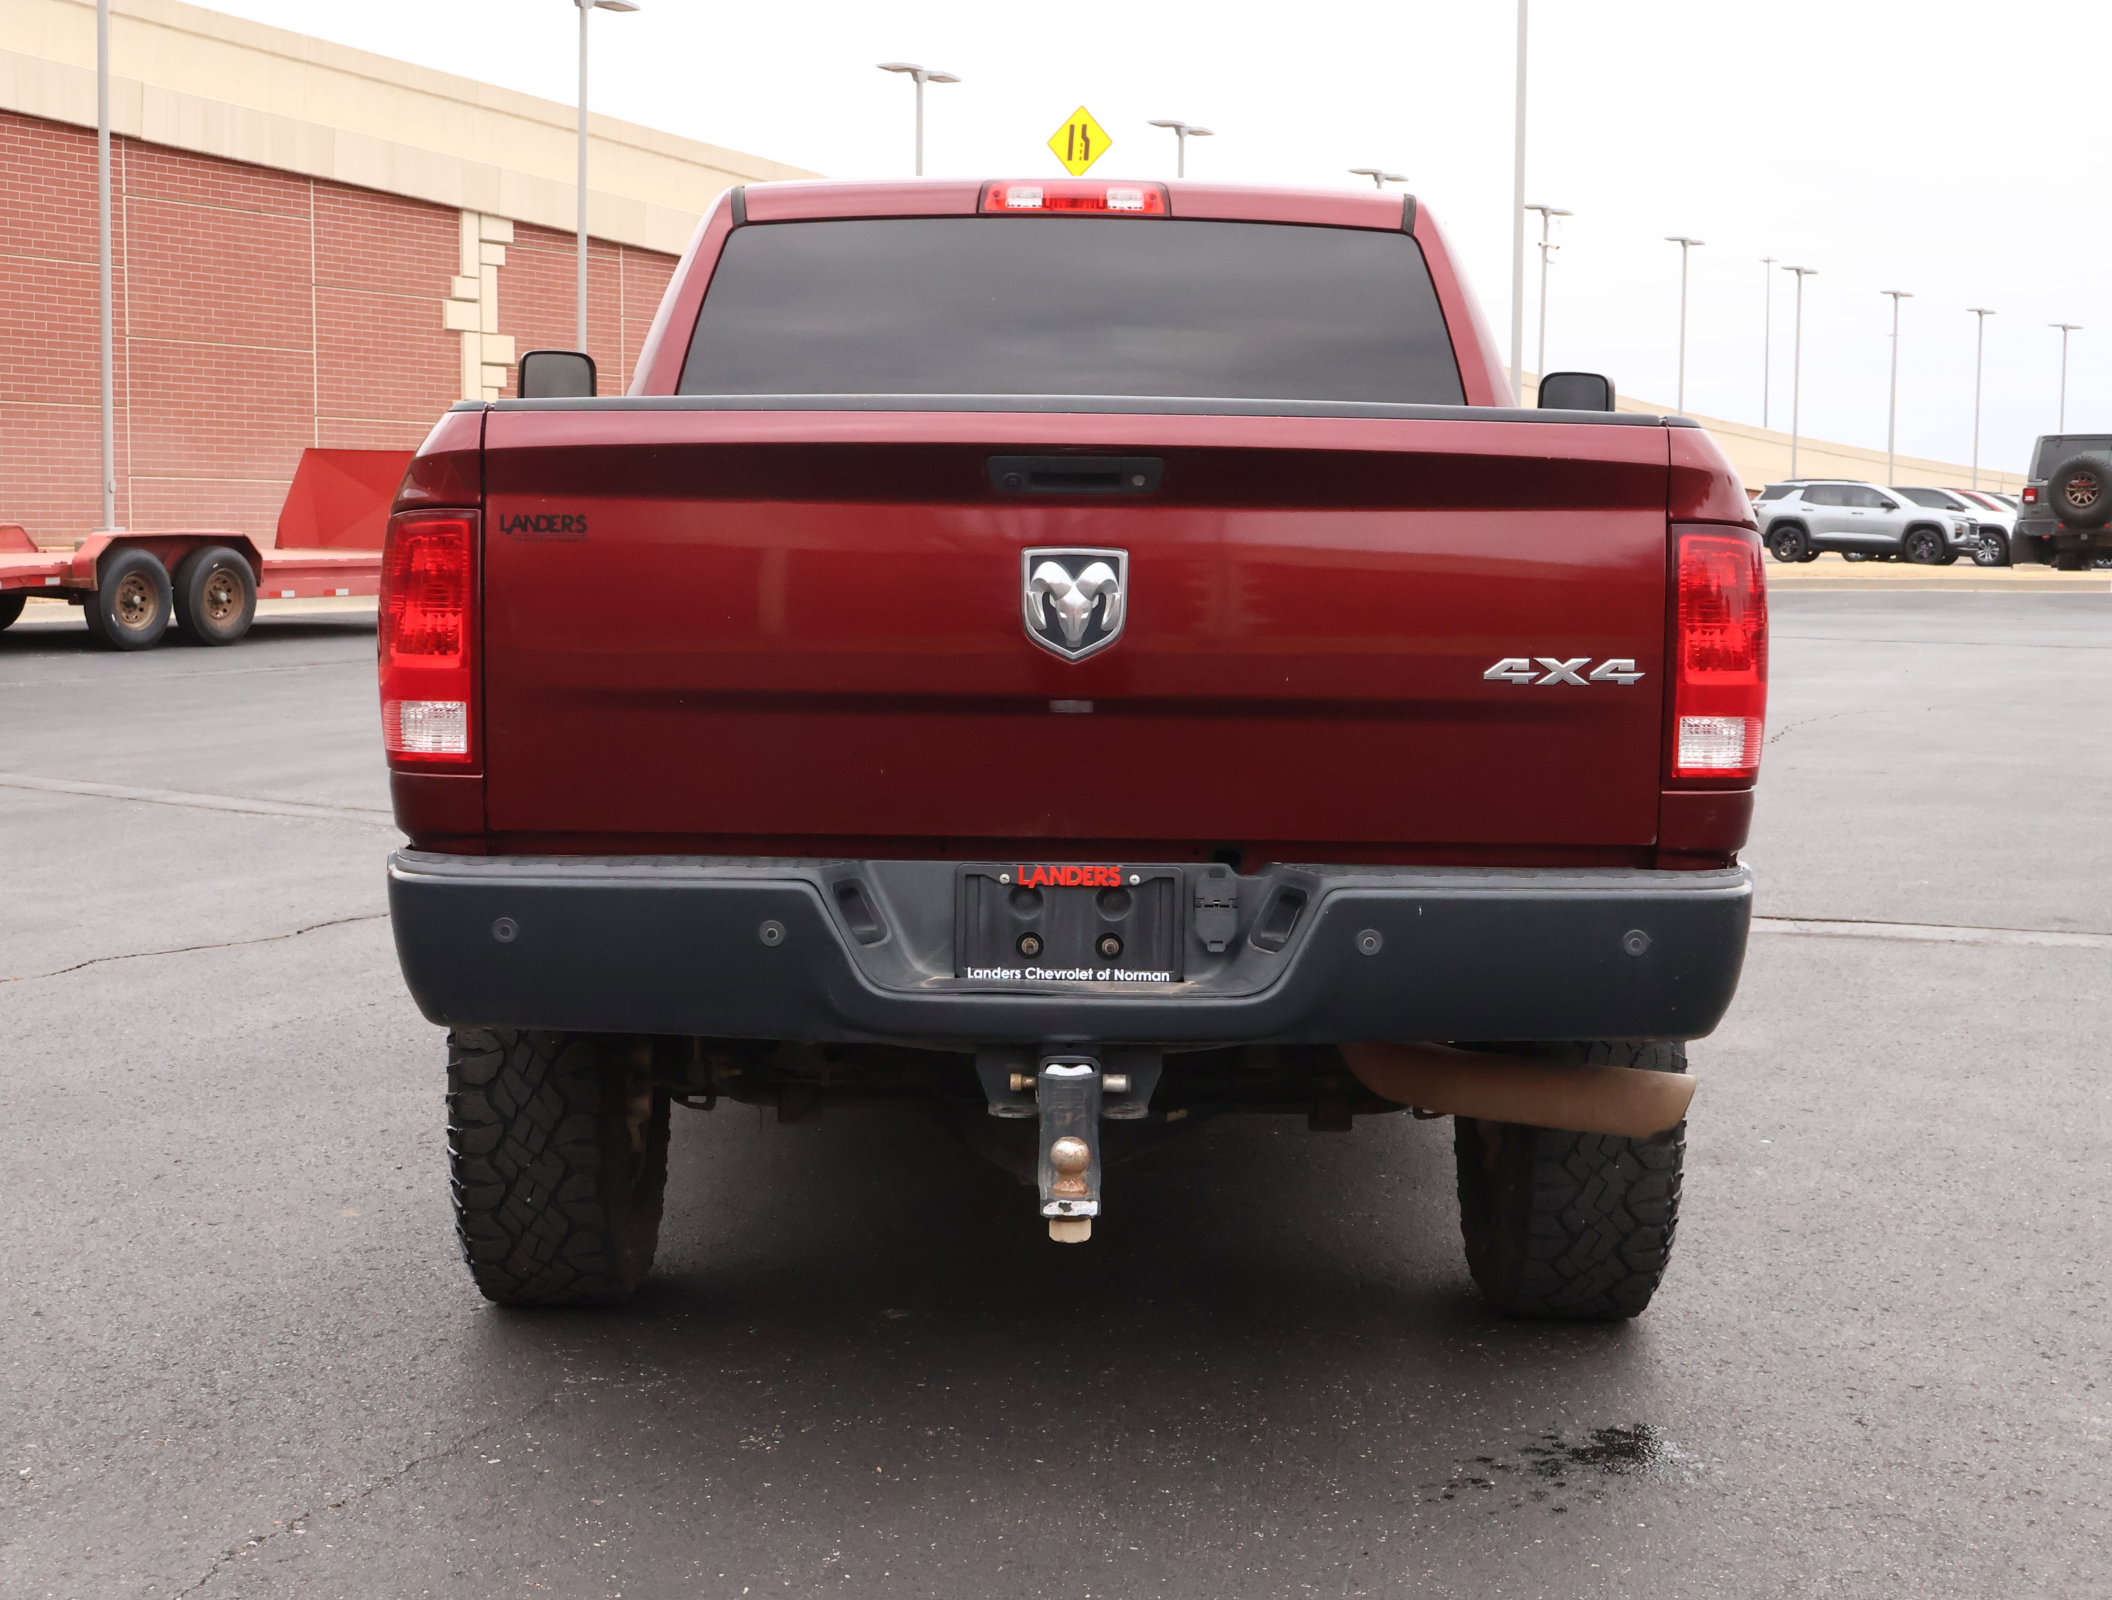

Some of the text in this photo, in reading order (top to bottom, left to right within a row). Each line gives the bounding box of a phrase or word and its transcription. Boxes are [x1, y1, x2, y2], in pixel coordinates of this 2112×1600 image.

[499, 514, 588, 535] LANDERS
[1483, 657, 1646, 686] 4X4
[1018, 865, 1122, 888] LANDERS
[967, 967, 1170, 982] Landers Chevrolet of Norman
